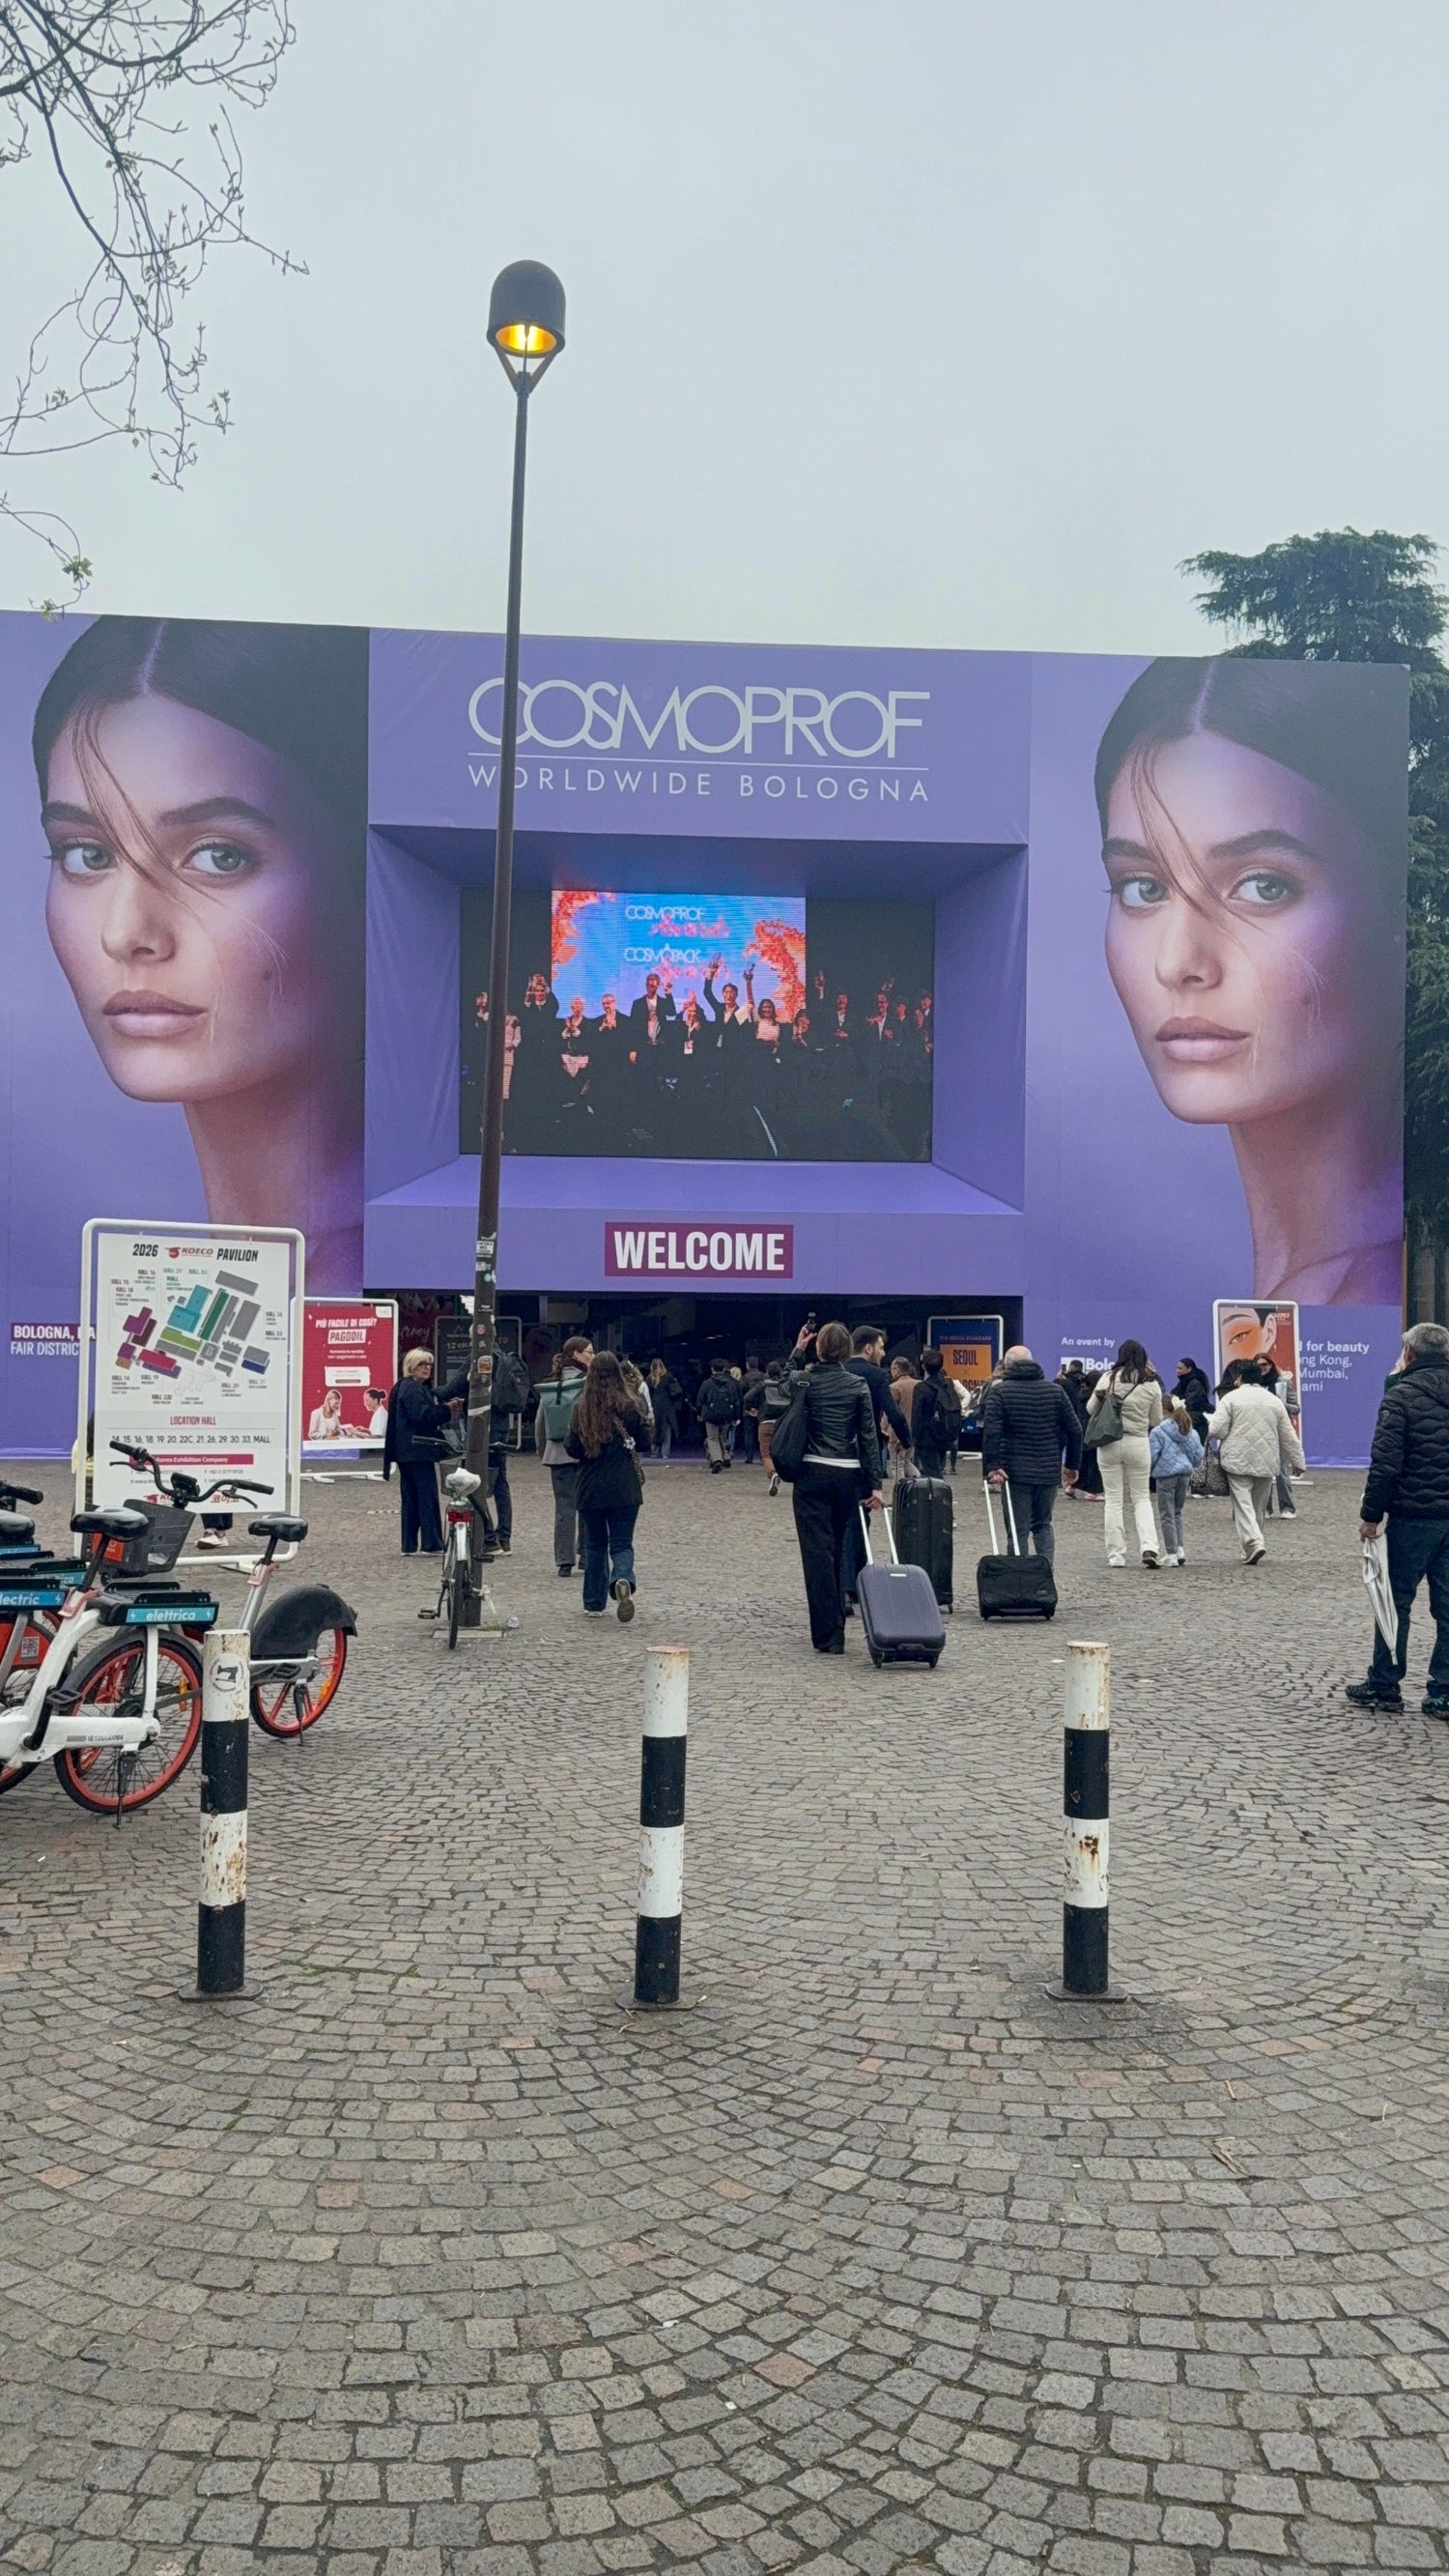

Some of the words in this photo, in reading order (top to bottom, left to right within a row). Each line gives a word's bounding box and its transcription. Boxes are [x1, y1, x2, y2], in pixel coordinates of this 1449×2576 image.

[468, 677, 930, 758] COSMOPROF
[468, 765, 711, 795] WORLDWIDE
[740, 775, 929, 801] BOLOGNA
[625, 905, 705, 921] COSMOPROF
[132, 1244, 159, 1257] 2026
[216, 1248, 258, 1262] PAVILION
[613, 1231, 785, 1271] WELCOME
[328, 1319, 349, 1328] FACILE
[350, 1319, 358, 1328] DI
[14, 1325, 74, 1342] BOLOGNA,
[330, 1331, 364, 1342] PAGODIL
[11, 1341, 34, 1355] FAIR
[37, 1342, 80, 1356] DISTRIC
[1061, 1337, 1074, 1346] An
[1104, 1338, 1115, 1348] by
[1306, 1340, 1324, 1351] for
[1327, 1341, 1370, 1354] beauty
[953, 1349, 979, 1365] SEOUL
[1320, 1354, 1352, 1368] Kong,
[170, 1416, 200, 1425] LOCATION
[201, 1416, 217, 1425] HALL
[0, 1592, 40, 1605] lectric
[146, 1609, 195, 1622] elettrica
